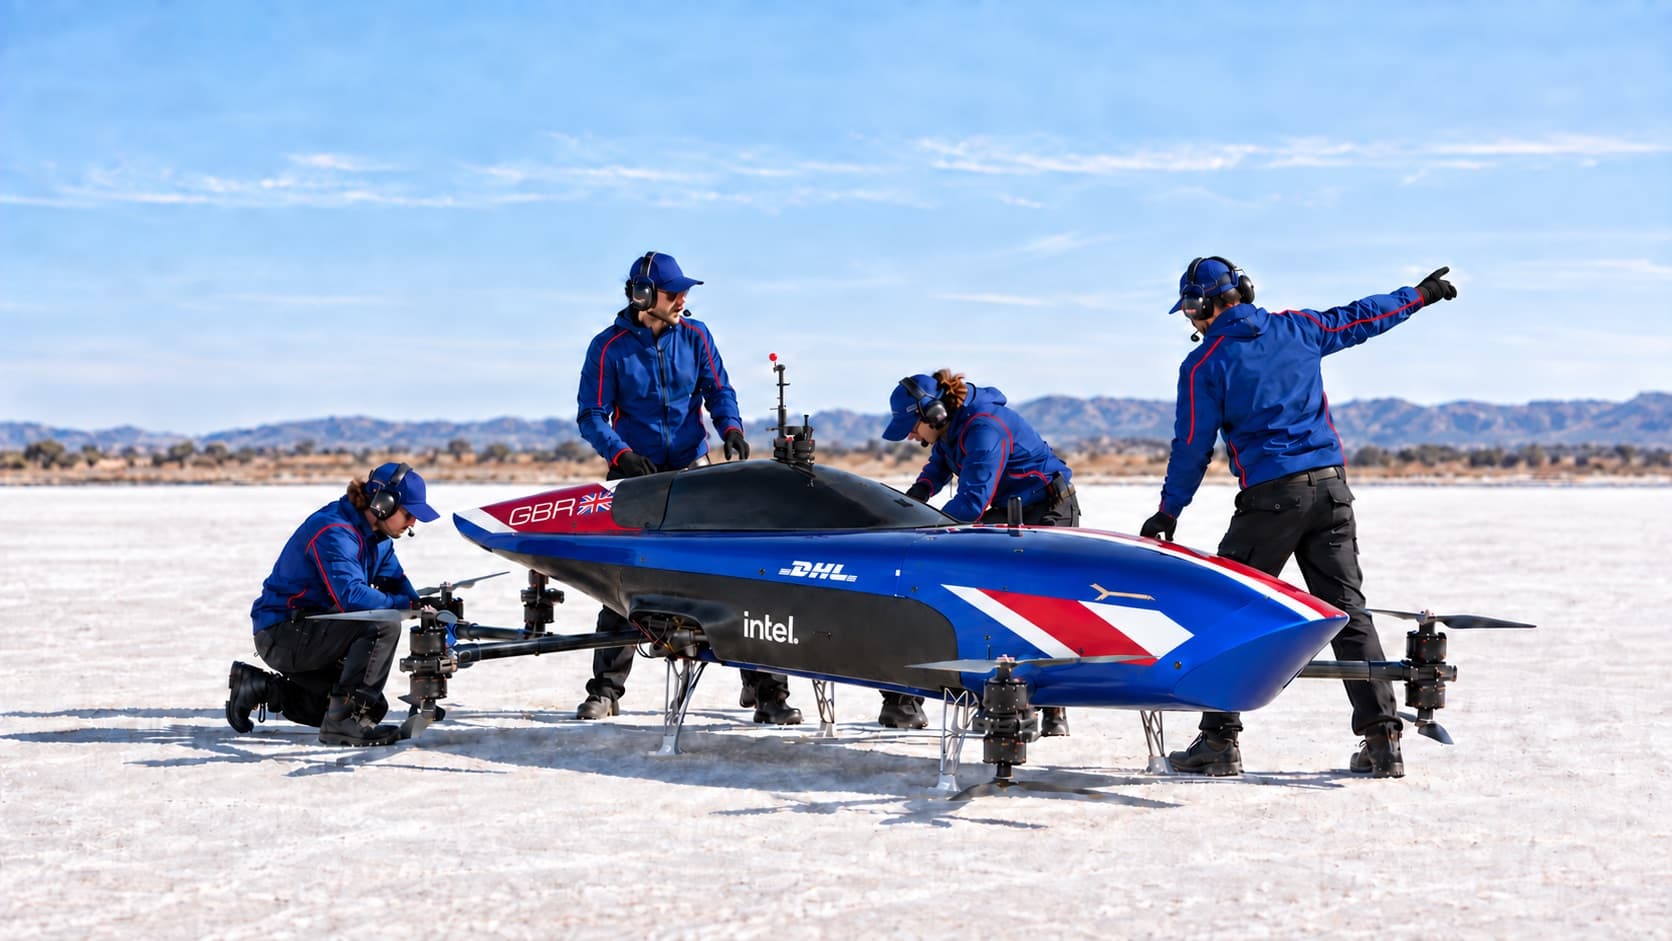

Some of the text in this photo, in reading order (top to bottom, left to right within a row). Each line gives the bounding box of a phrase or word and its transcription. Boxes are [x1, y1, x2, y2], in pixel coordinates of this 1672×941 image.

[509, 498, 576, 526] GBR
[789, 560, 849, 581] DHL
[743, 610, 799, 645] intel.
